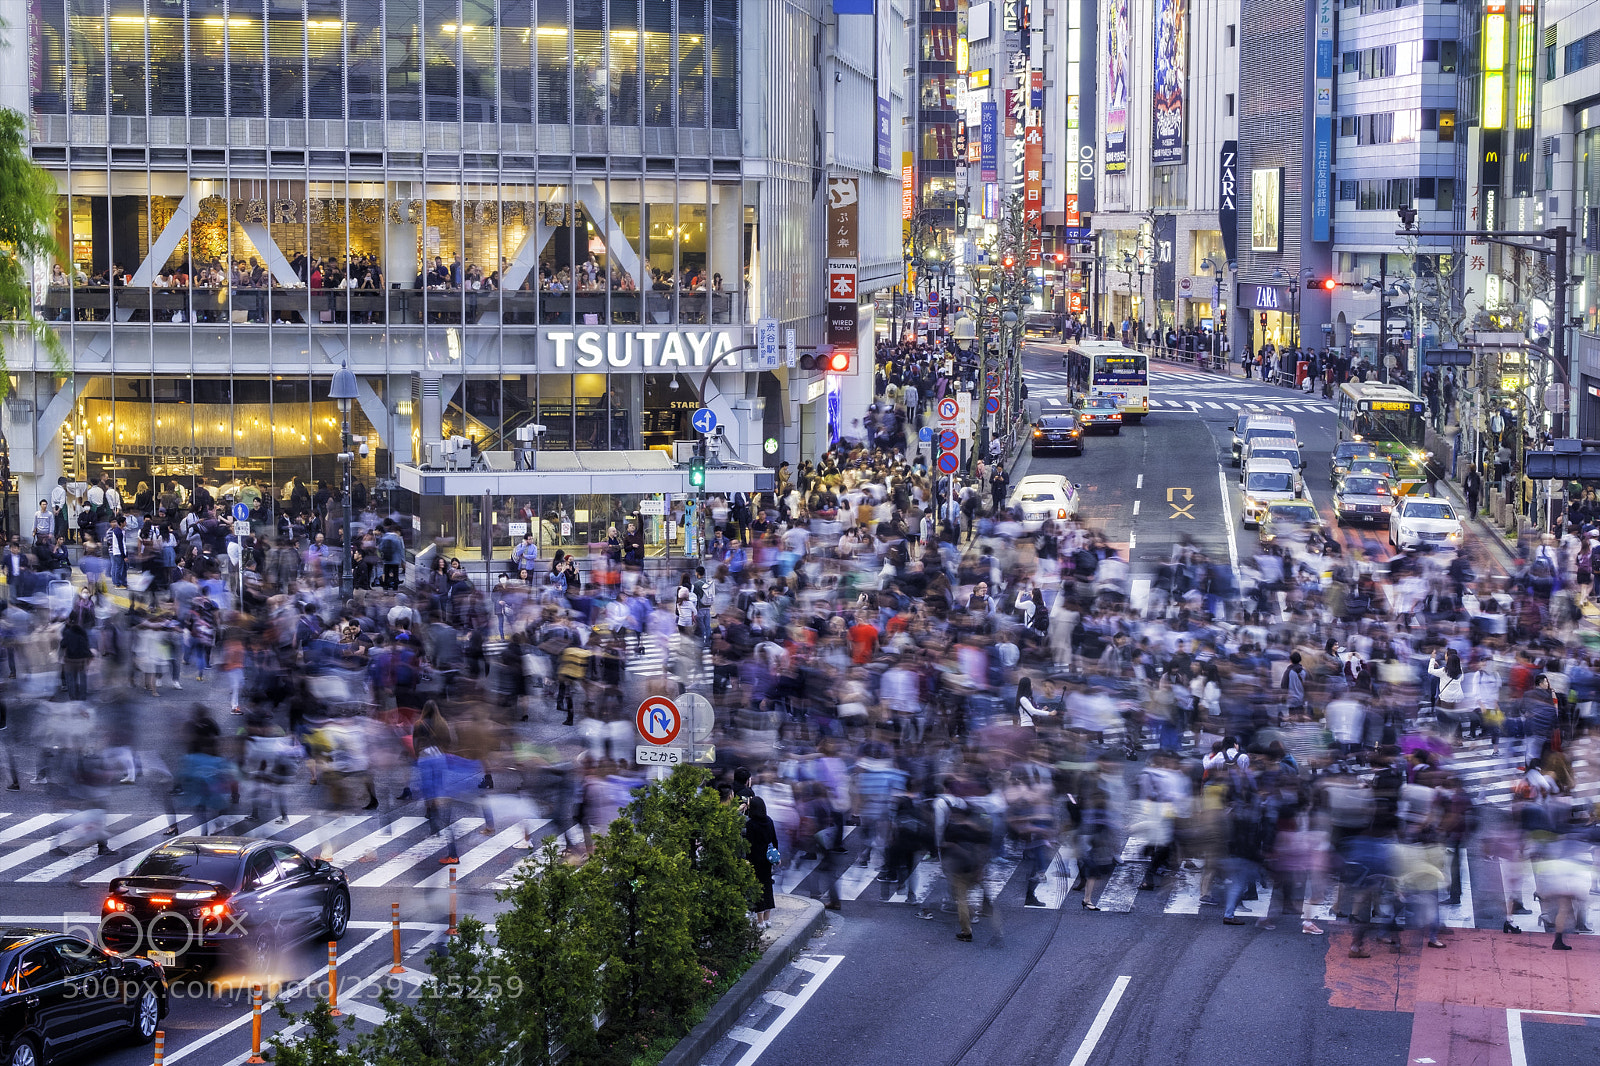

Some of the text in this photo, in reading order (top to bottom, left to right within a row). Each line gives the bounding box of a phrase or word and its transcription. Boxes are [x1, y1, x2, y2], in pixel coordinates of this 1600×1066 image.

[903, 165, 912, 219] TOWER RECORDS
[1222, 152, 1236, 210] ZARA
[1317, 141, 1328, 217] 三井住友信託銀行
[199, 197, 583, 227] STARBUCKS COFFEE
[1027, 170, 1040, 261] 東日本行
[833, 276, 853, 296] 本
[1256, 286, 1278, 308] ZARA
[547, 331, 738, 368] TSUTAYA
[766, 322, 776, 365] 渋谷駅前
[112, 444, 233, 456] STARBUCKS COFFEE
[639, 751, 679, 763] ここから
